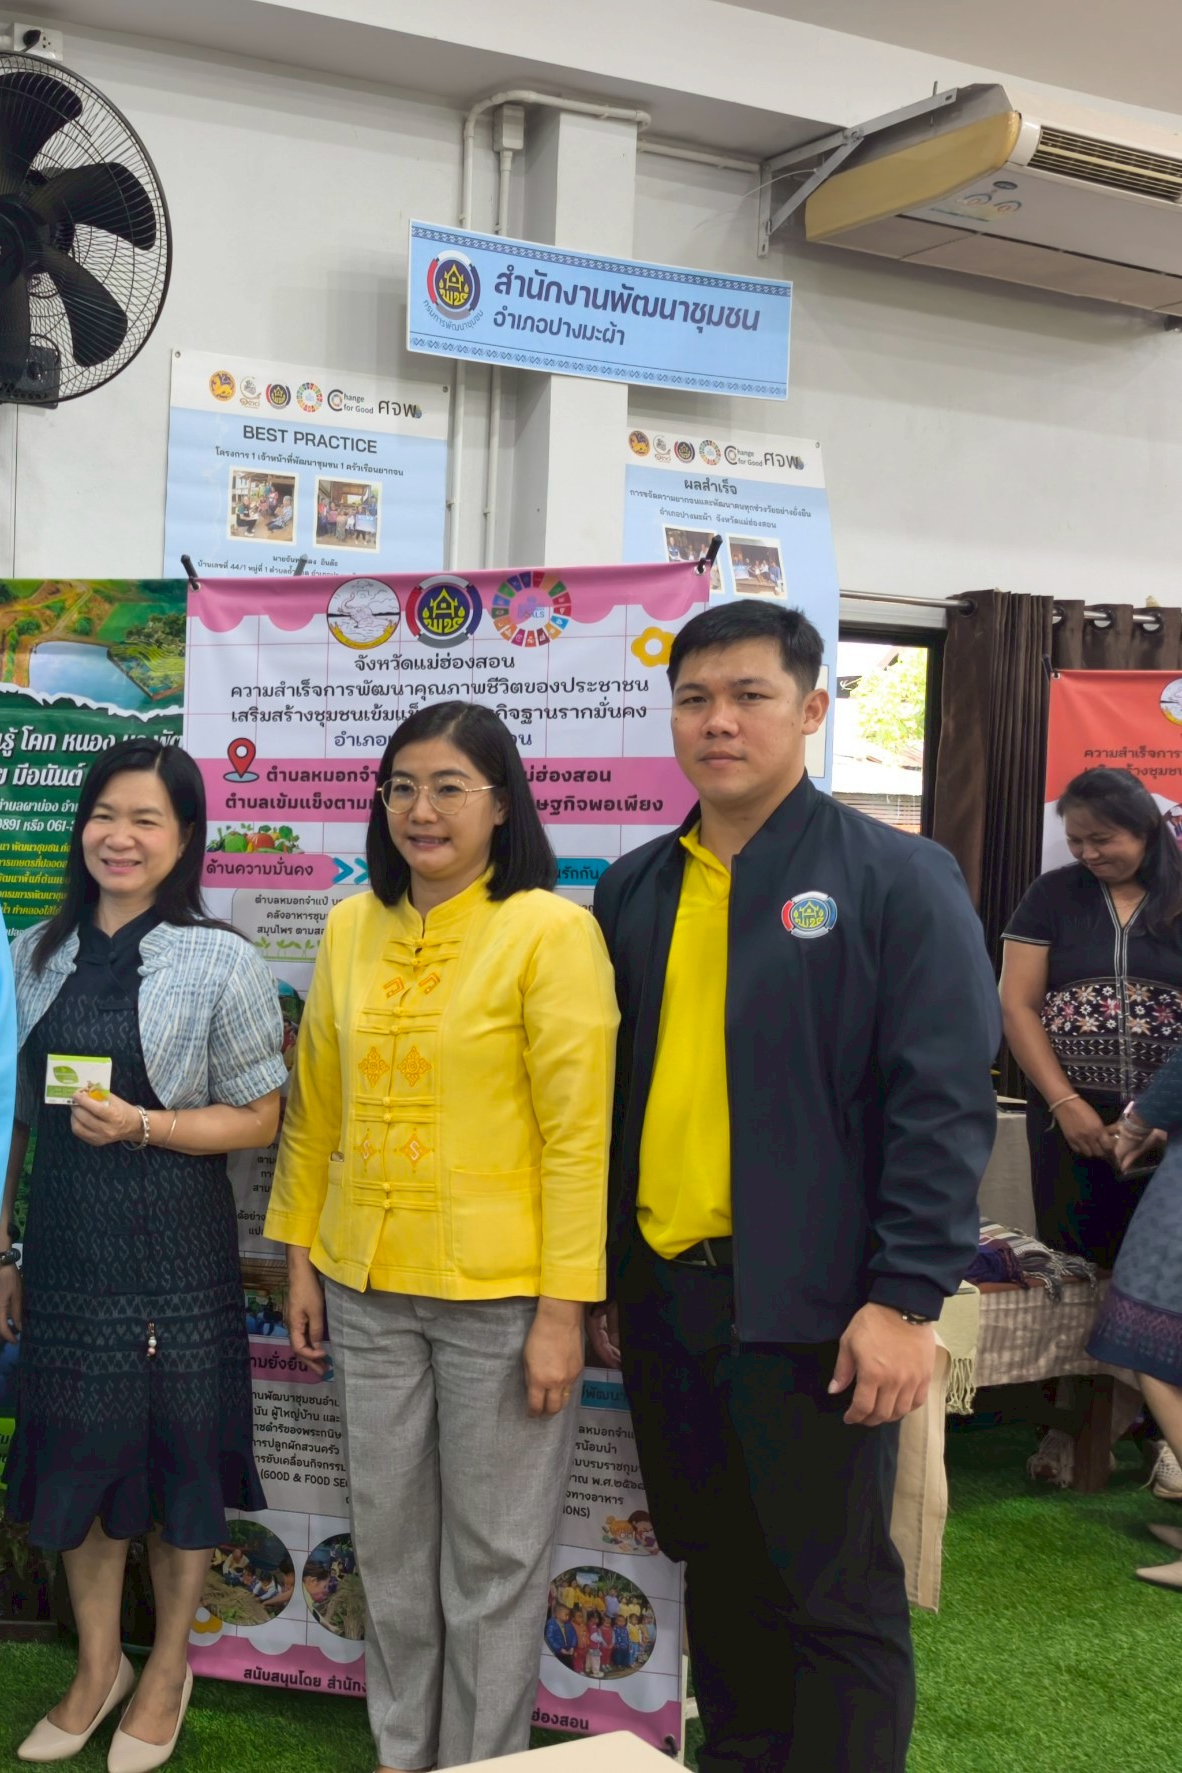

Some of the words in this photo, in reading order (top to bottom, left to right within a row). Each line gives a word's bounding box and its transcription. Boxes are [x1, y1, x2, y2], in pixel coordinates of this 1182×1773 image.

[494, 265, 761, 334] สำนักงานพัฒนาชุมชน
[493, 306, 625, 346] อำเภอปางมะผ้า
[355, 404, 374, 415] Good
[243, 424, 288, 444] BEST
[293, 431, 378, 454] PRACTICE
[215, 446, 250, 460] โครงการ
[684, 478, 738, 495] ผลสำเร็จ
[354, 653, 515, 671] จังหวัดแม่ฮ่องสอน
[231, 677, 649, 701] ความสำเร็จการพัฒนาคุณภาพชีวิตของประชาชน
[490, 697, 647, 725] กิจฐานรากมั่นคง
[20, 725, 56, 751] โคก
[62, 733, 116, 752] หนอง
[334, 731, 391, 747] อำเภอ
[23, 819, 44, 832] หรือ
[206, 857, 314, 876] ด้านความมั่นคง
[266, 910, 328, 923] คลังอาหารชุม
[257, 925, 293, 936] สมุนไพร
[260, 1468, 290, 1481] (GOOD
[293, 1474, 302, 1483] &
[304, 1474, 331, 1486] FOOD
[243, 1666, 322, 1688] สนับสนุนโดย
